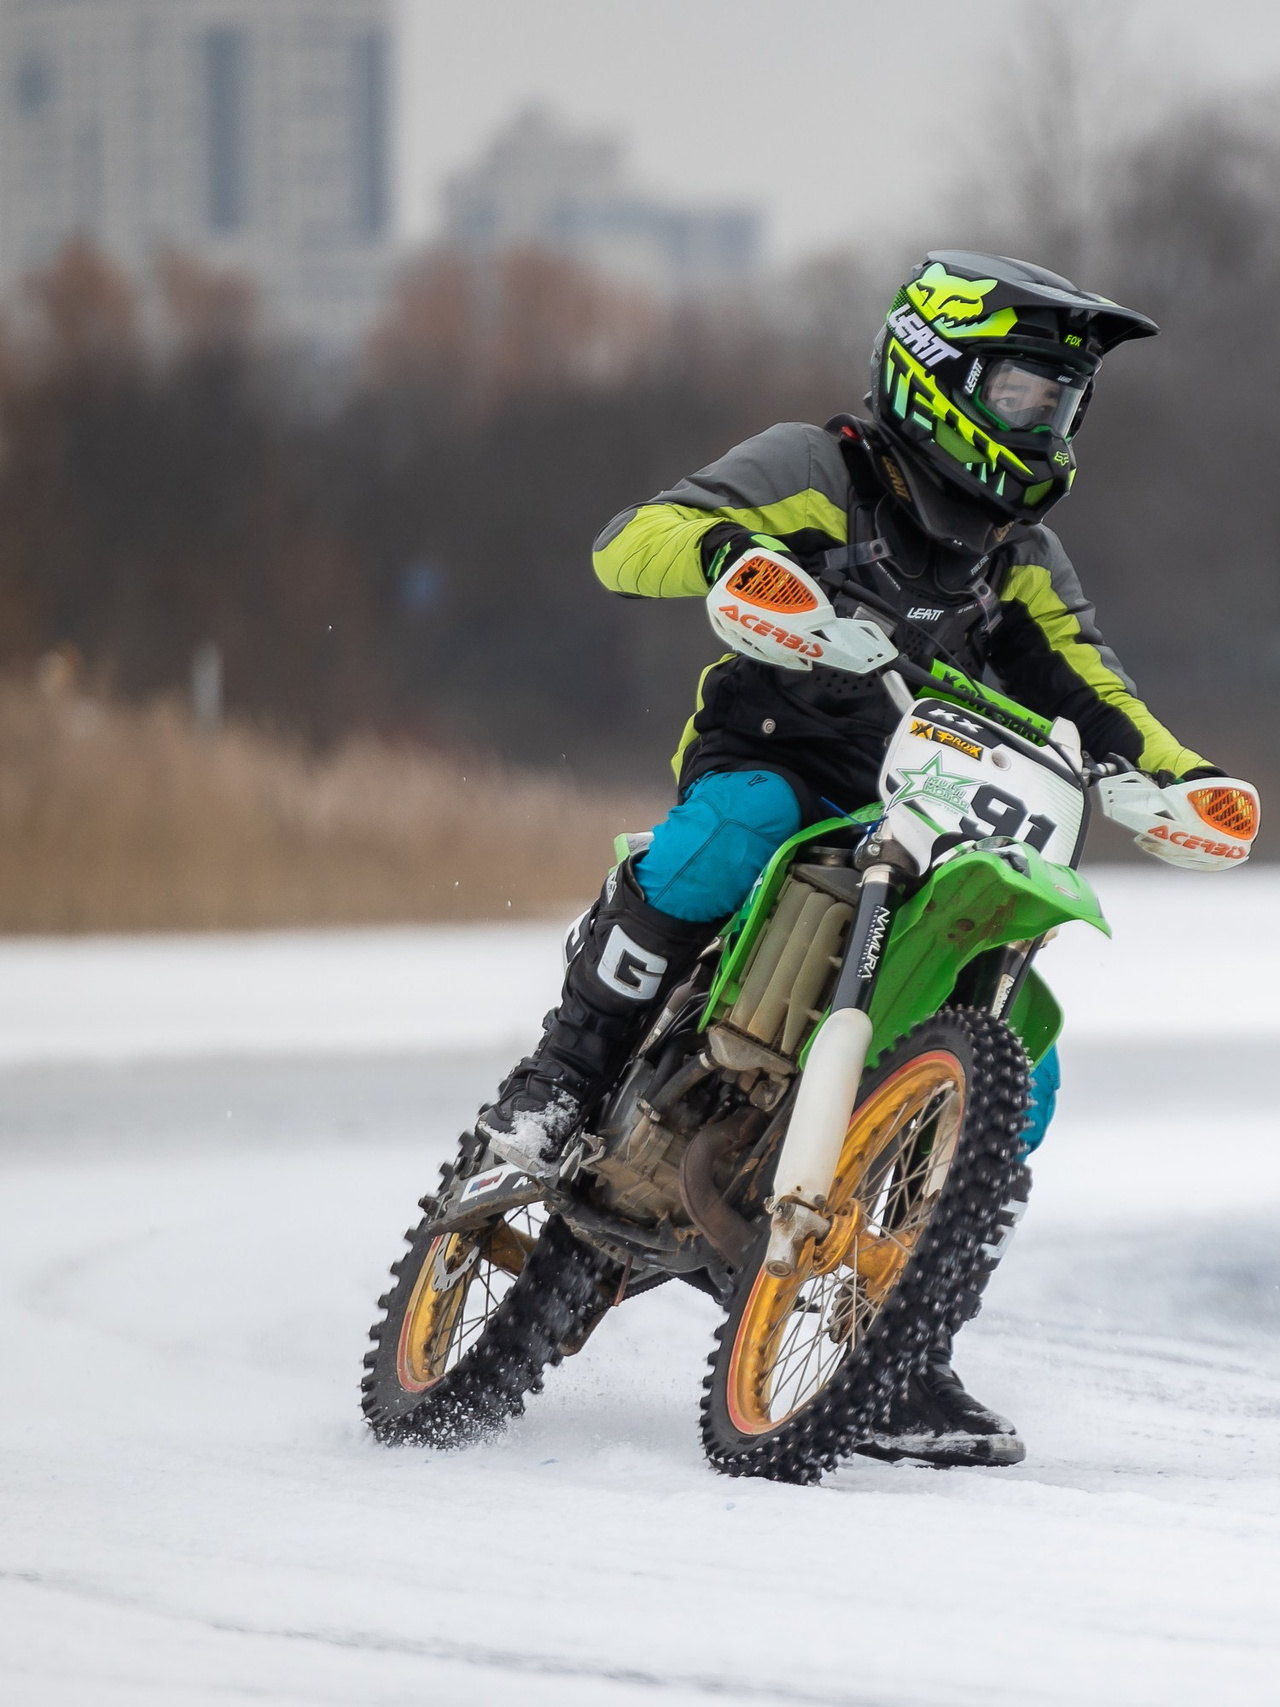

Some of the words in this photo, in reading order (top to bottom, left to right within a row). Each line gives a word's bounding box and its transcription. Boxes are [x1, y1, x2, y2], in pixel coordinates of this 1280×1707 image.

[888, 303, 963, 367] LEATT
[1065, 334, 1083, 347] FOX
[964, 358, 984, 396] LEATT
[719, 605, 824, 658] ACERBIS
[907, 607, 945, 621] LEATT
[928, 708, 985, 733] KX
[959, 783, 1058, 855] 91
[1148, 825, 1247, 860] ACERBIS
[861, 906, 891, 978] NAMURA
